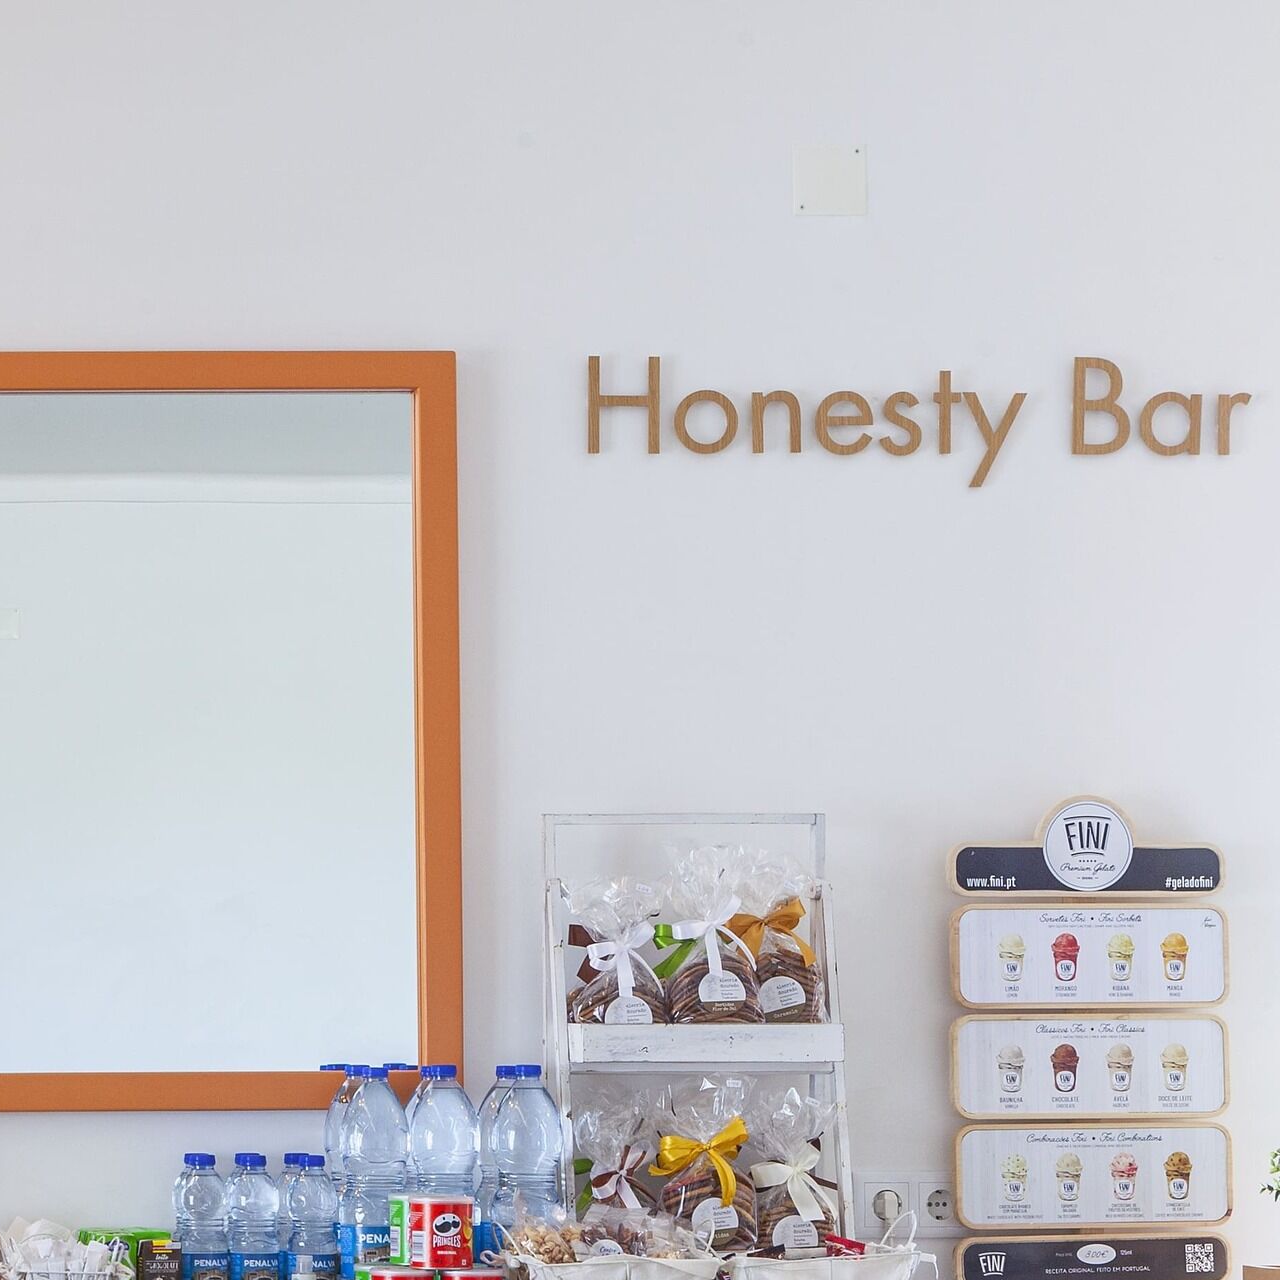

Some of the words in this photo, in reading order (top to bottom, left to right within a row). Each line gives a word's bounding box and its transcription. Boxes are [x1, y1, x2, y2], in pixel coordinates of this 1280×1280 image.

[586, 355, 1028, 488] Honesty
[1071, 356, 1253, 456] Bar
[1063, 820, 1110, 852] FINI
[1059, 862, 1092, 873] Premium
[966, 874, 1017, 890] www.fini.pt
[1165, 875, 1214, 891] #geladofini
[432, 1234, 462, 1249] PRINGLES
[980, 1253, 1006, 1274] FINI
[1121, 1265, 1151, 1273] PORTUGAL
